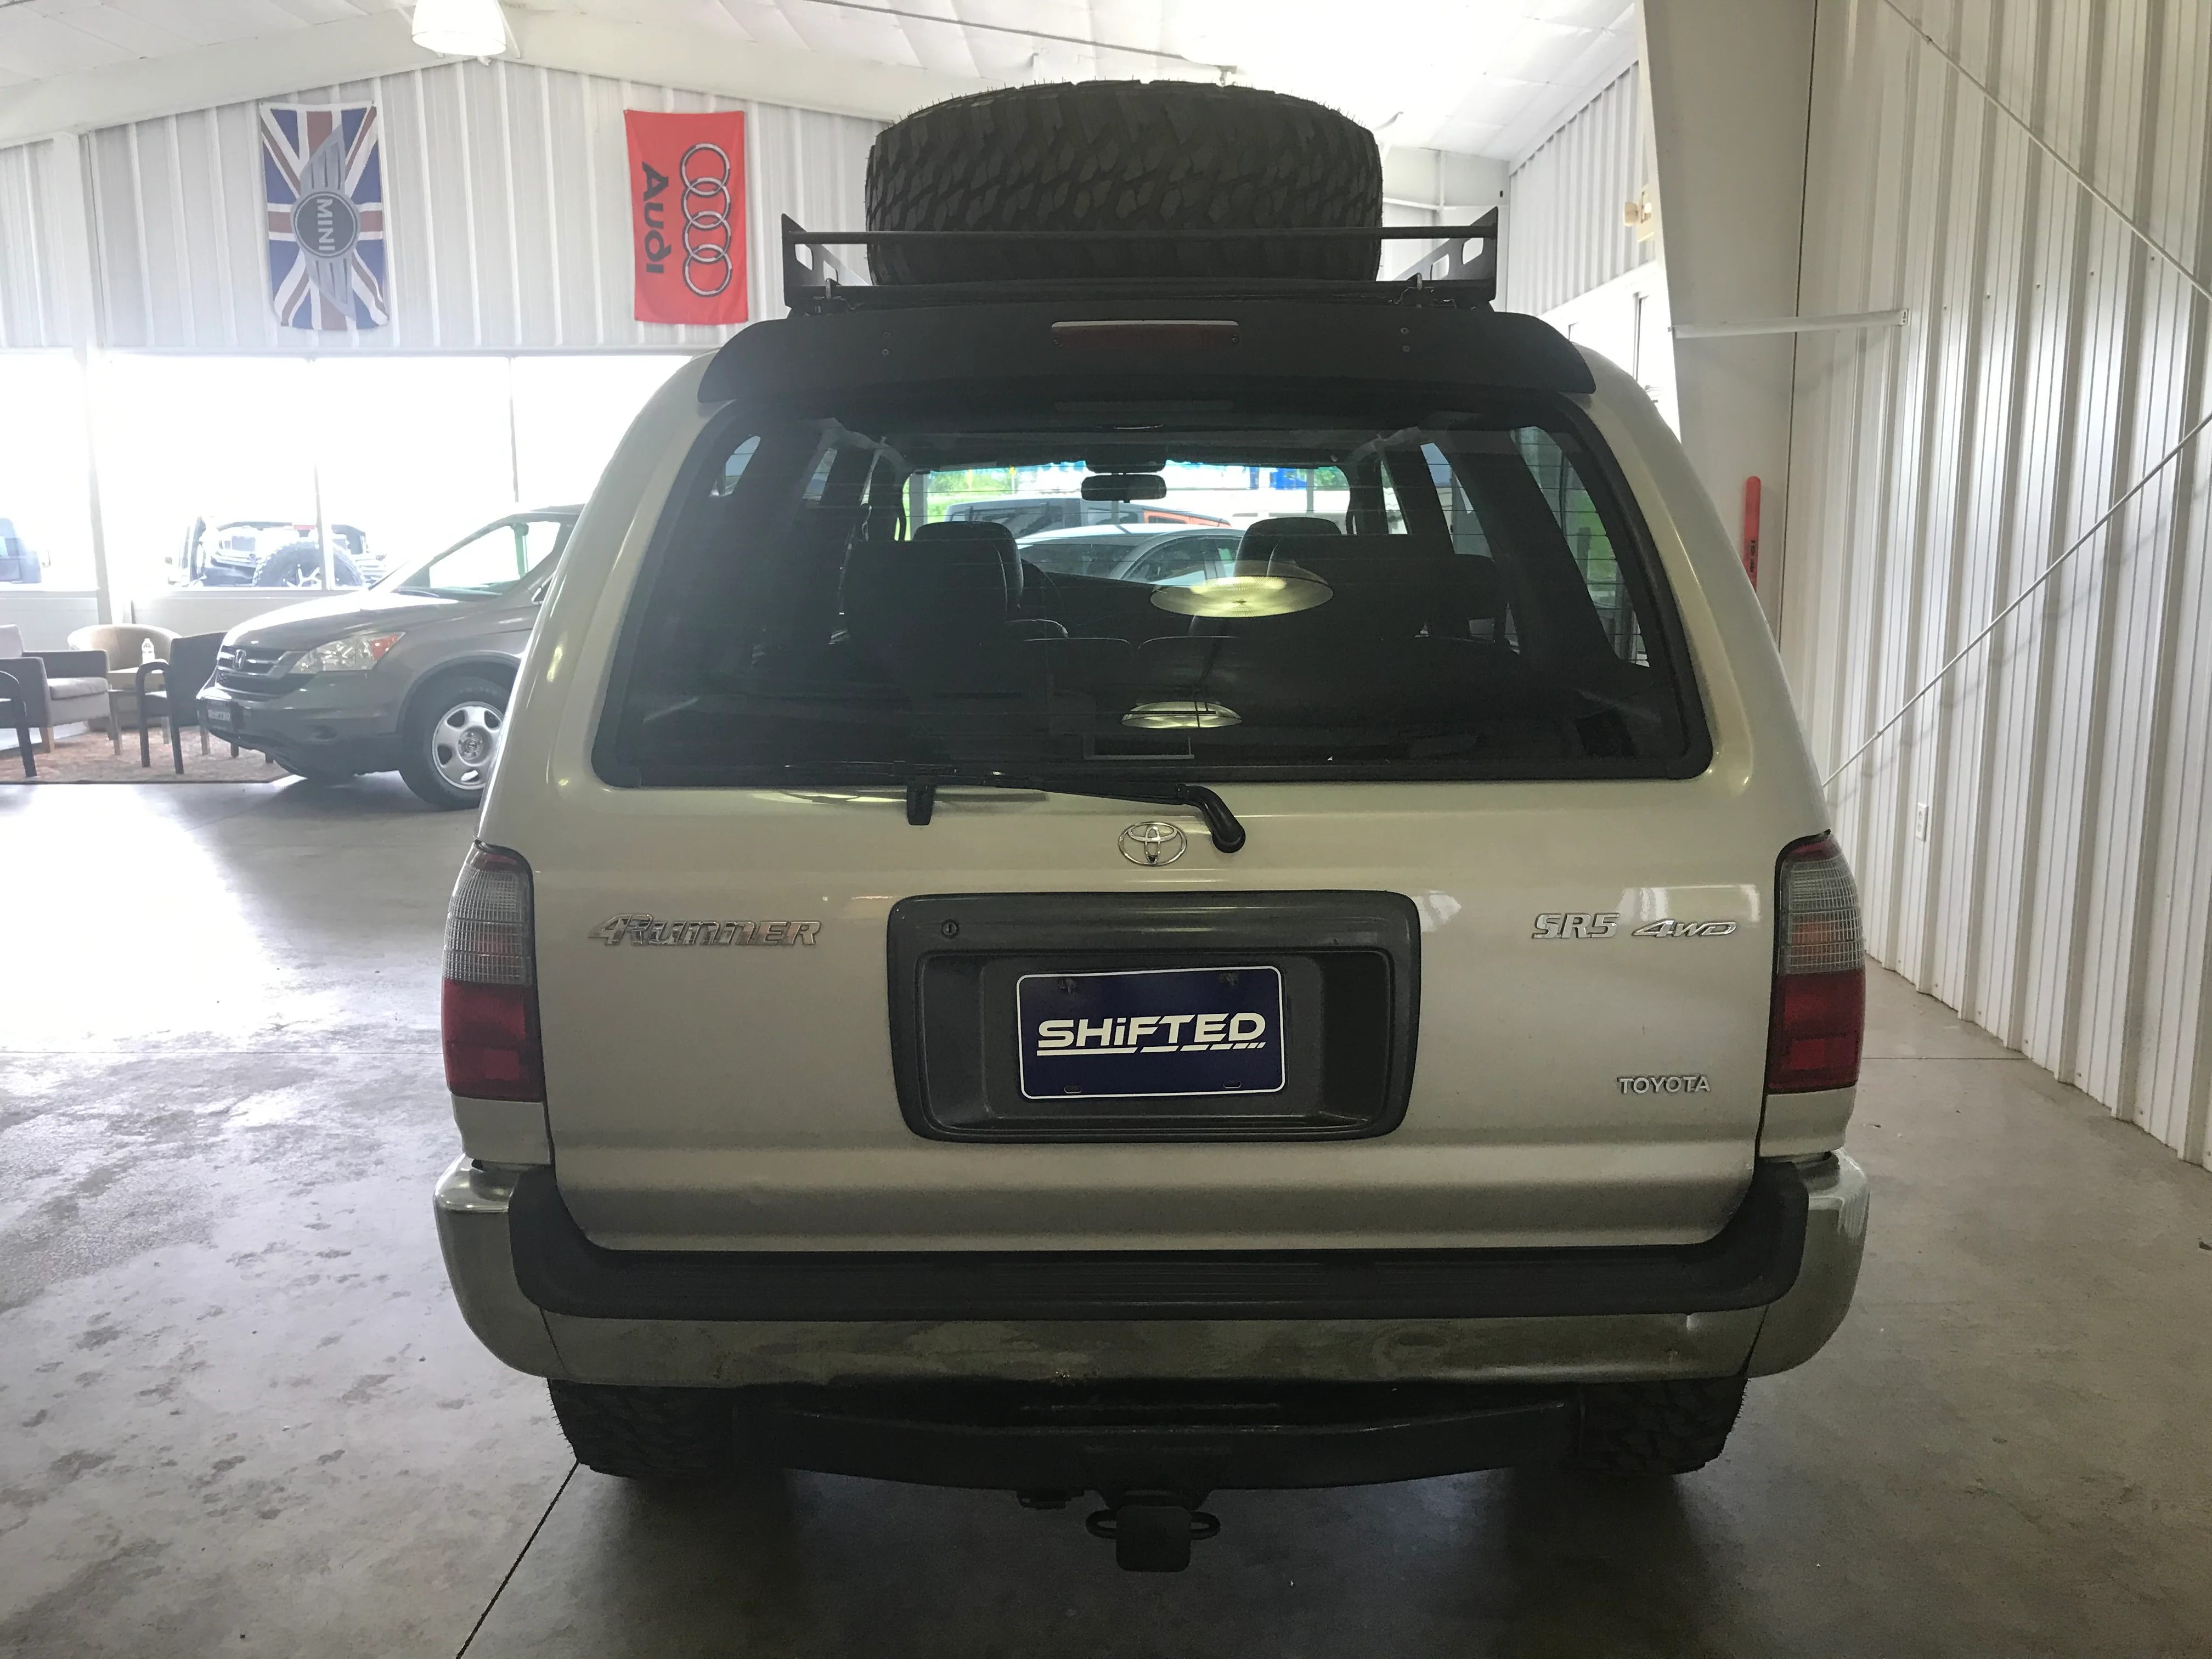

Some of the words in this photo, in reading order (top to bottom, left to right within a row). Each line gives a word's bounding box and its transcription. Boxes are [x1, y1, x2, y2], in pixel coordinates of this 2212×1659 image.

[317, 199, 335, 251] MINI
[641, 161, 672, 274] Audi
[1532, 912, 1620, 939] SR5
[1631, 918, 1738, 938] 4WD
[1616, 1075, 1711, 1094] TOYOTA
